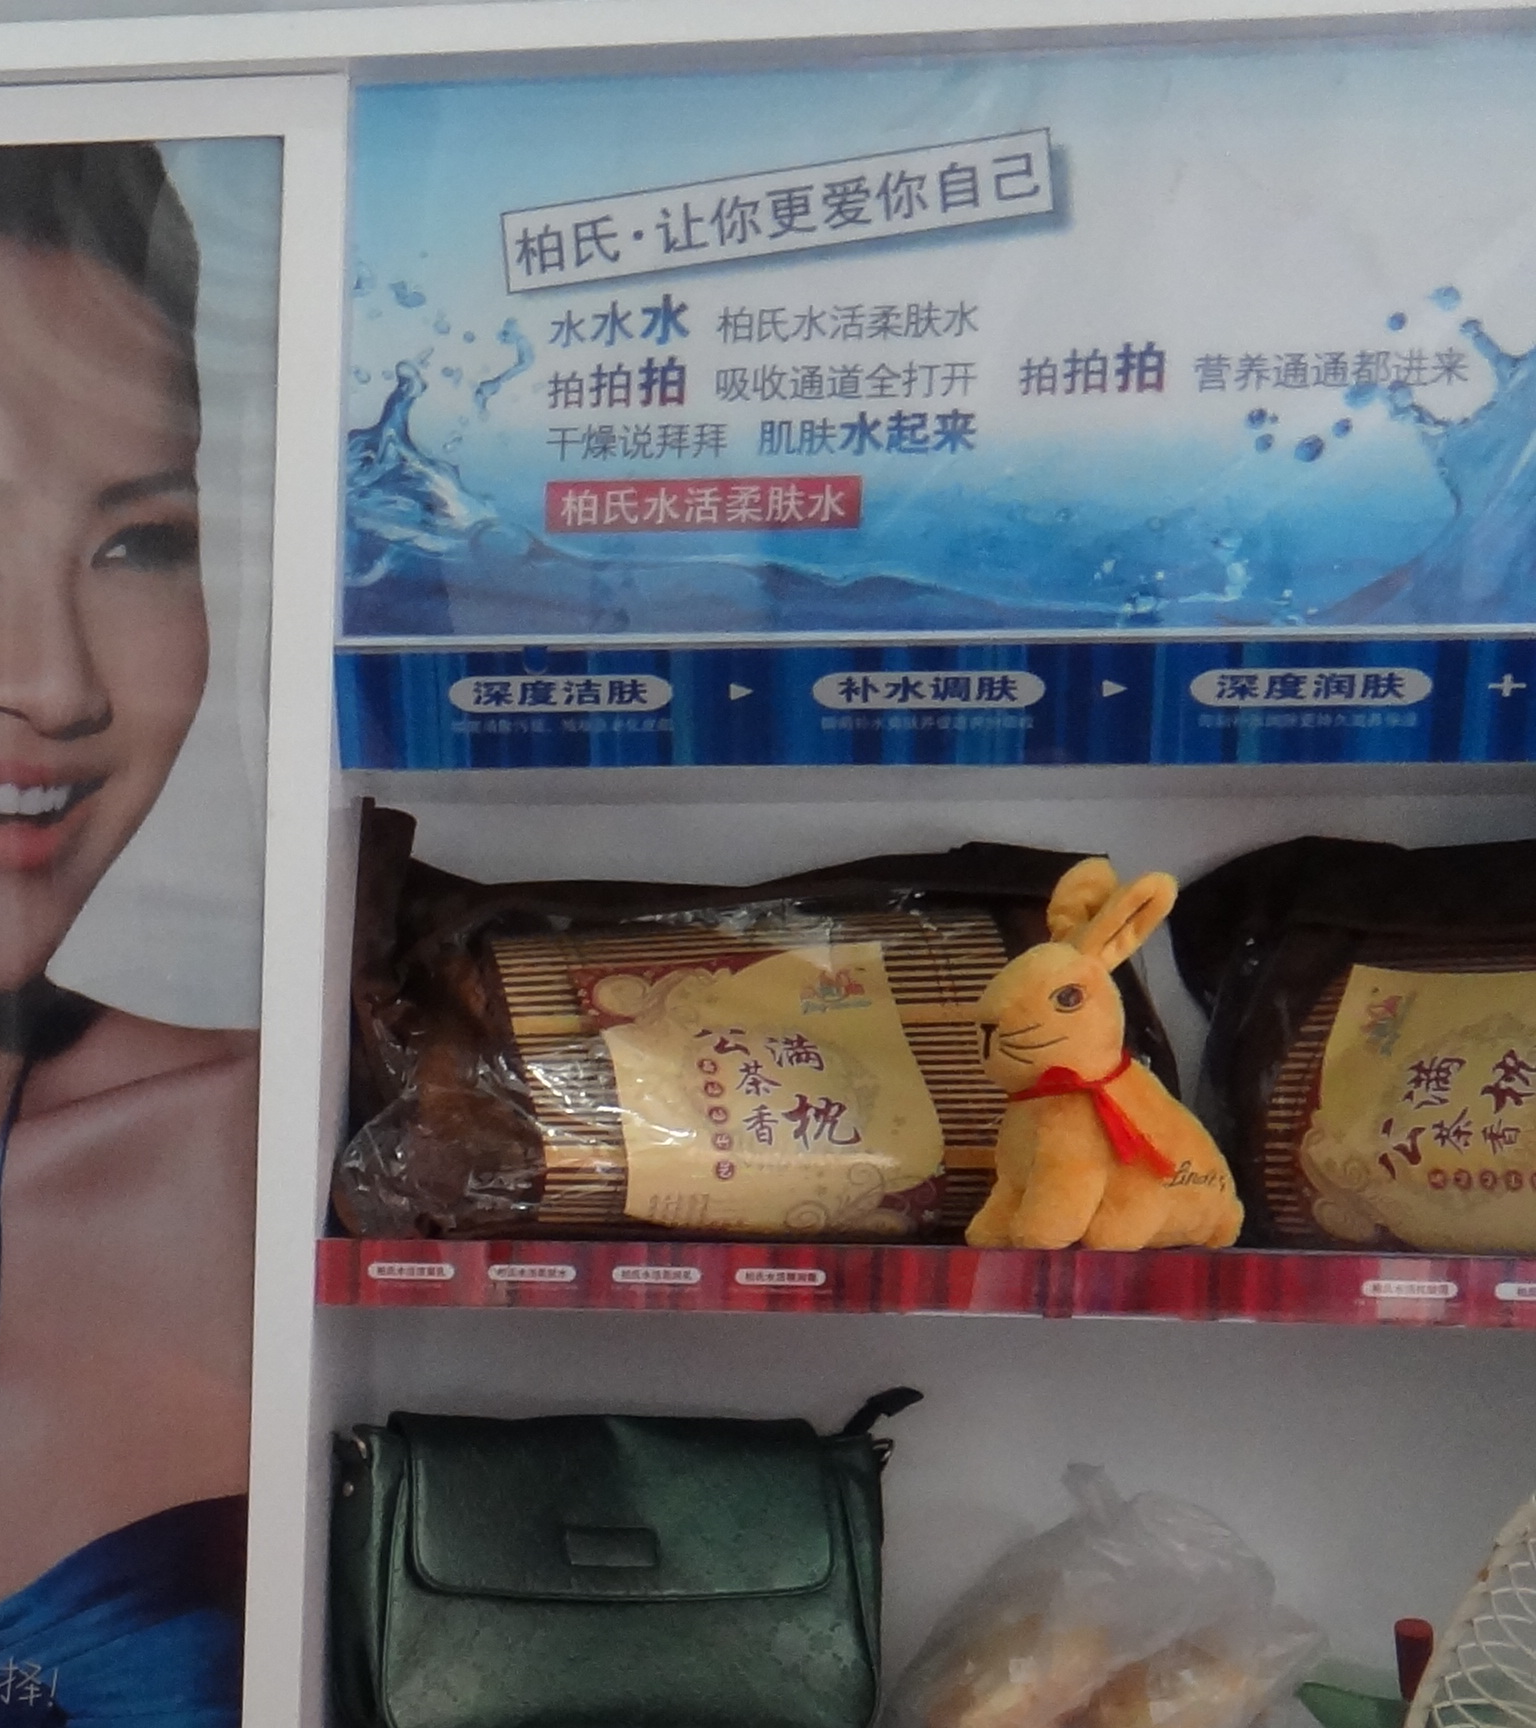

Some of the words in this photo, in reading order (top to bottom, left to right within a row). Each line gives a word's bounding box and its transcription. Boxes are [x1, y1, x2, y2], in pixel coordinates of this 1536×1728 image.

[514, 152, 1040, 275] 柏氏·让你更爱你自己
[548, 297, 690, 345] 水水水
[718, 301, 980, 342] 柏氏水活柔肤水
[548, 357, 688, 410] 拍拍拍
[715, 361, 980, 404] 吸收通道全打开
[1019, 342, 1167, 398] 拍拍拍
[1194, 348, 1470, 393] 营养通通都进来
[547, 423, 728, 462] 干燥说拜拜
[758, 410, 978, 458] 肌肤水起来
[561, 483, 848, 529] 柏氏水活柔肤水
[472, 679, 649, 706] 深度洁肤
[838, 675, 1019, 704] 补水调肤
[1215, 673, 1406, 701] 深度润肤
